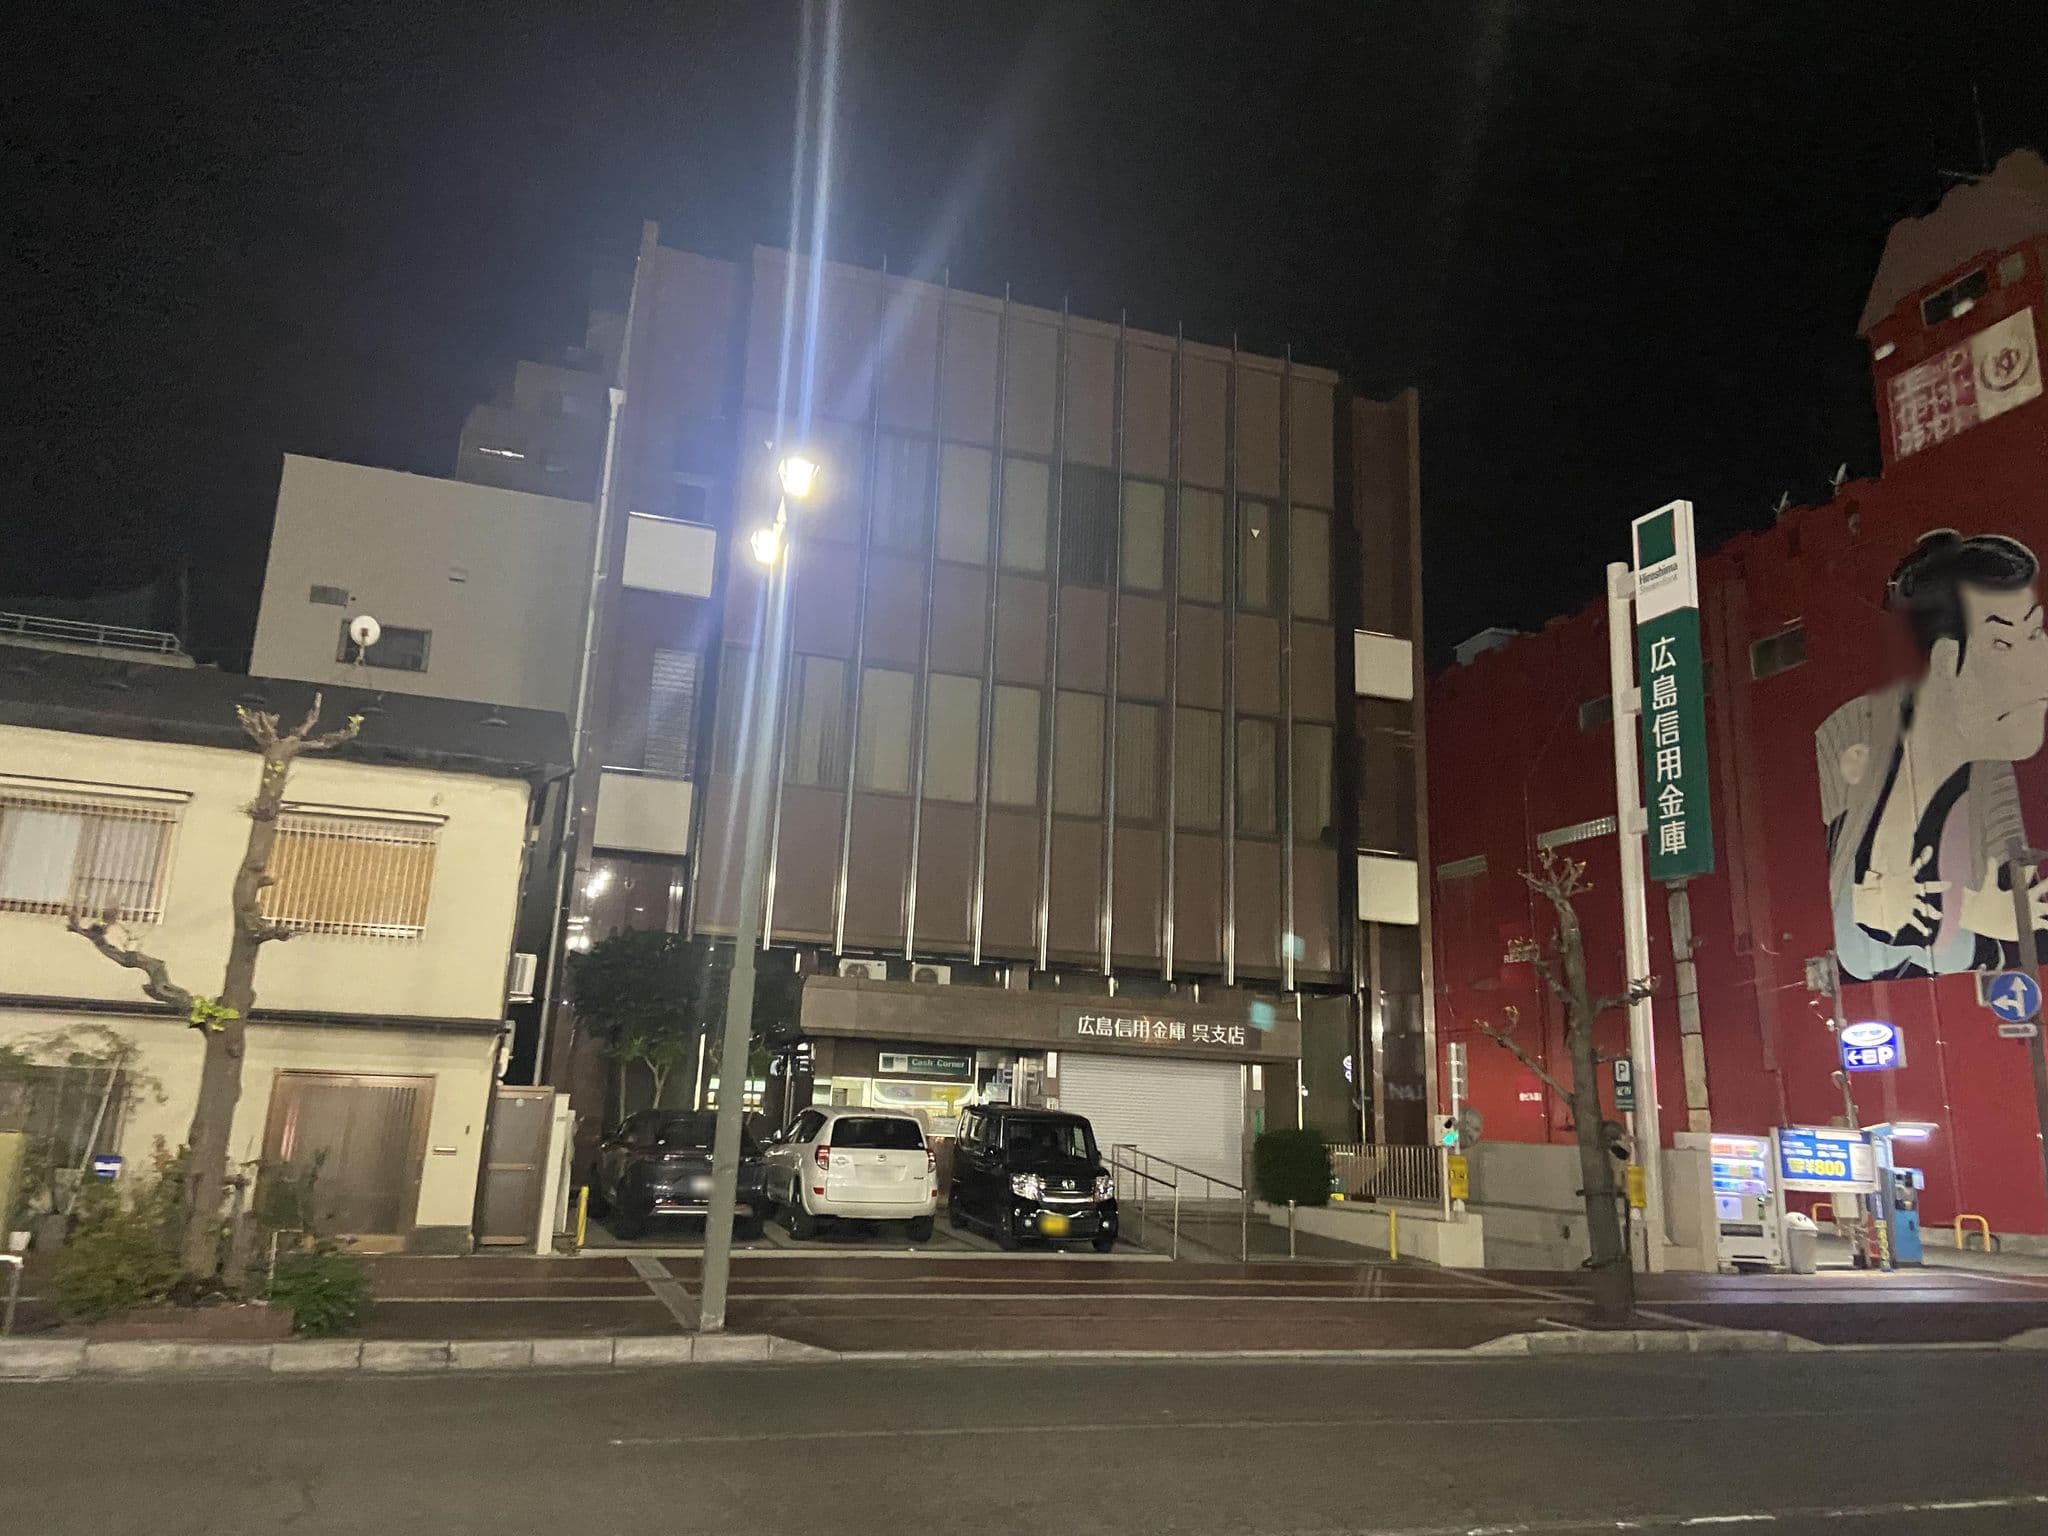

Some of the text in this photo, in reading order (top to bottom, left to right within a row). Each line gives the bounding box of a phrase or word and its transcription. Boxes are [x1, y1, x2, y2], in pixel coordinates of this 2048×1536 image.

[1650, 636, 1687, 856] 広島信用金庫
[1077, 1015, 1245, 1046] 広島信用金庫 呉支店
[911, 1058, 965, 1069] Cash Corner
[1877, 1046, 1894, 1065] P
[1618, 1063, 1627, 1079] P
